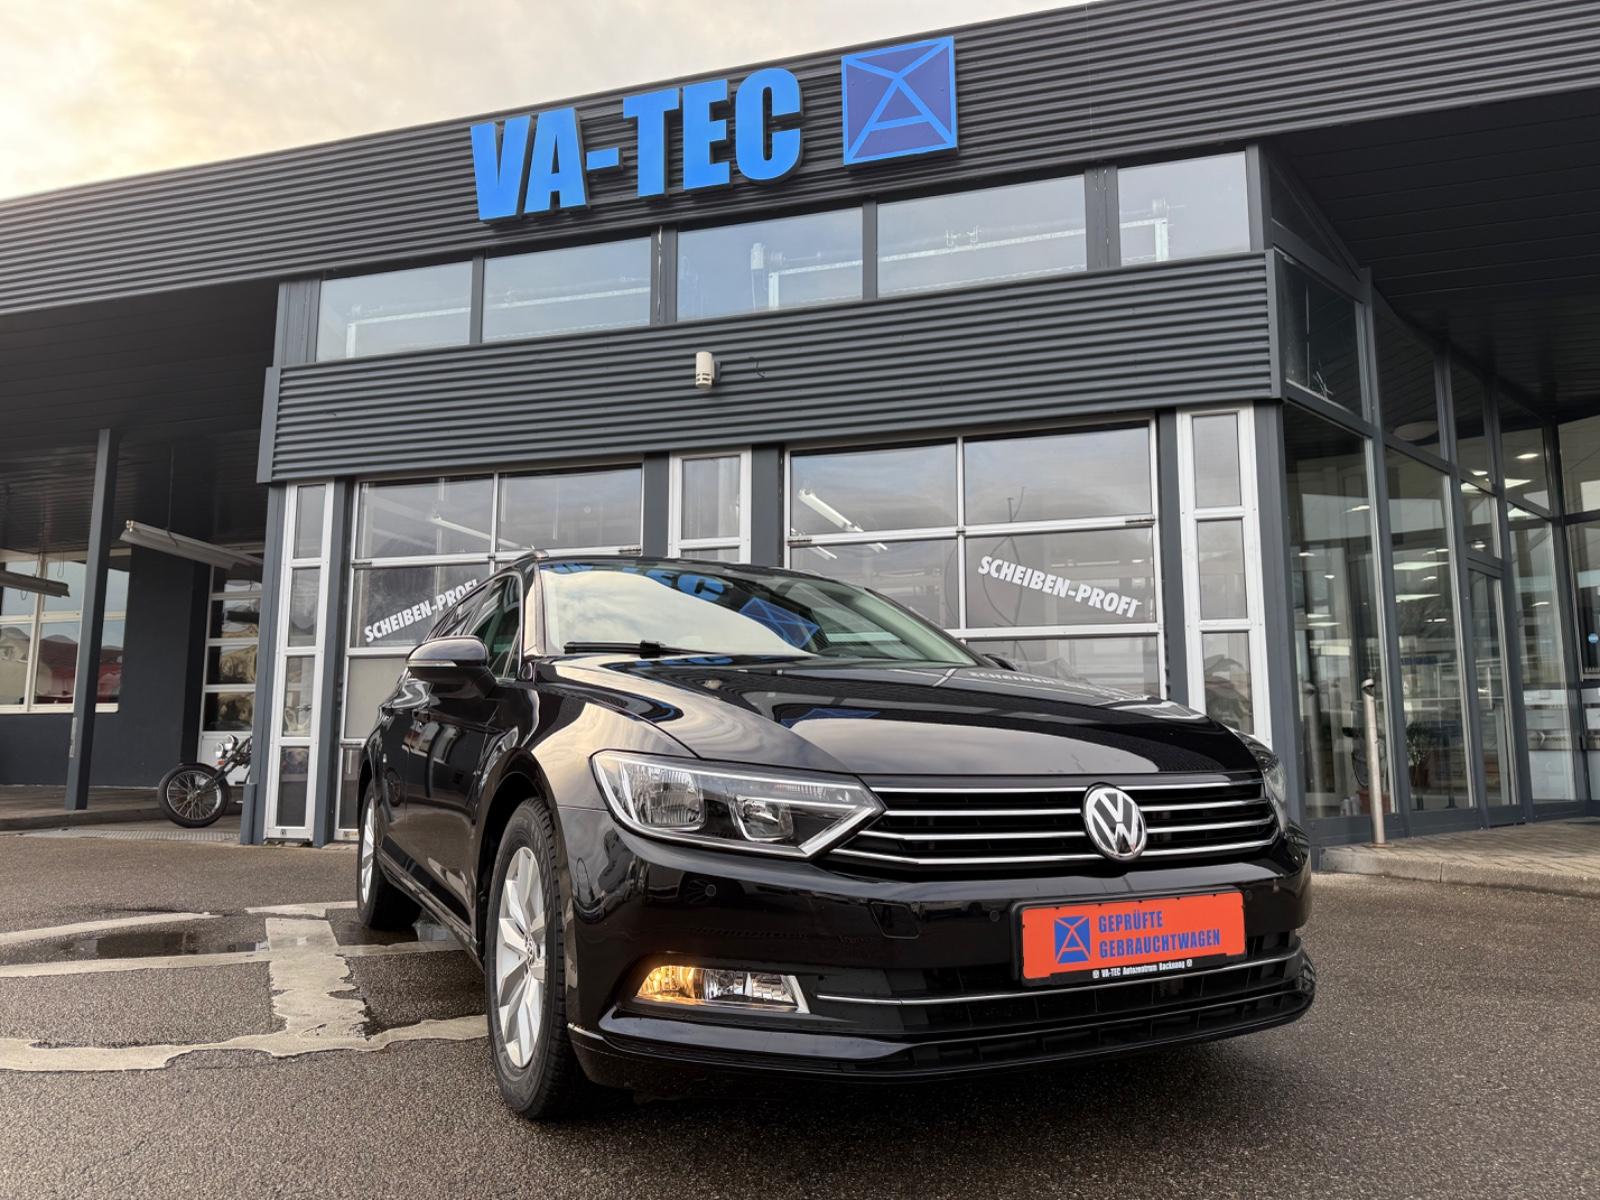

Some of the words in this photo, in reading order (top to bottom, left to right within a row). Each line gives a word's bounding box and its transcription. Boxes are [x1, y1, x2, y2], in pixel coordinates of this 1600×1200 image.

[470, 67, 803, 221] VA-TEC
[1098, 910, 1163, 933] GEPRÜFTE
[1099, 928, 1221, 959] GEBRAUCHTWAGEN
